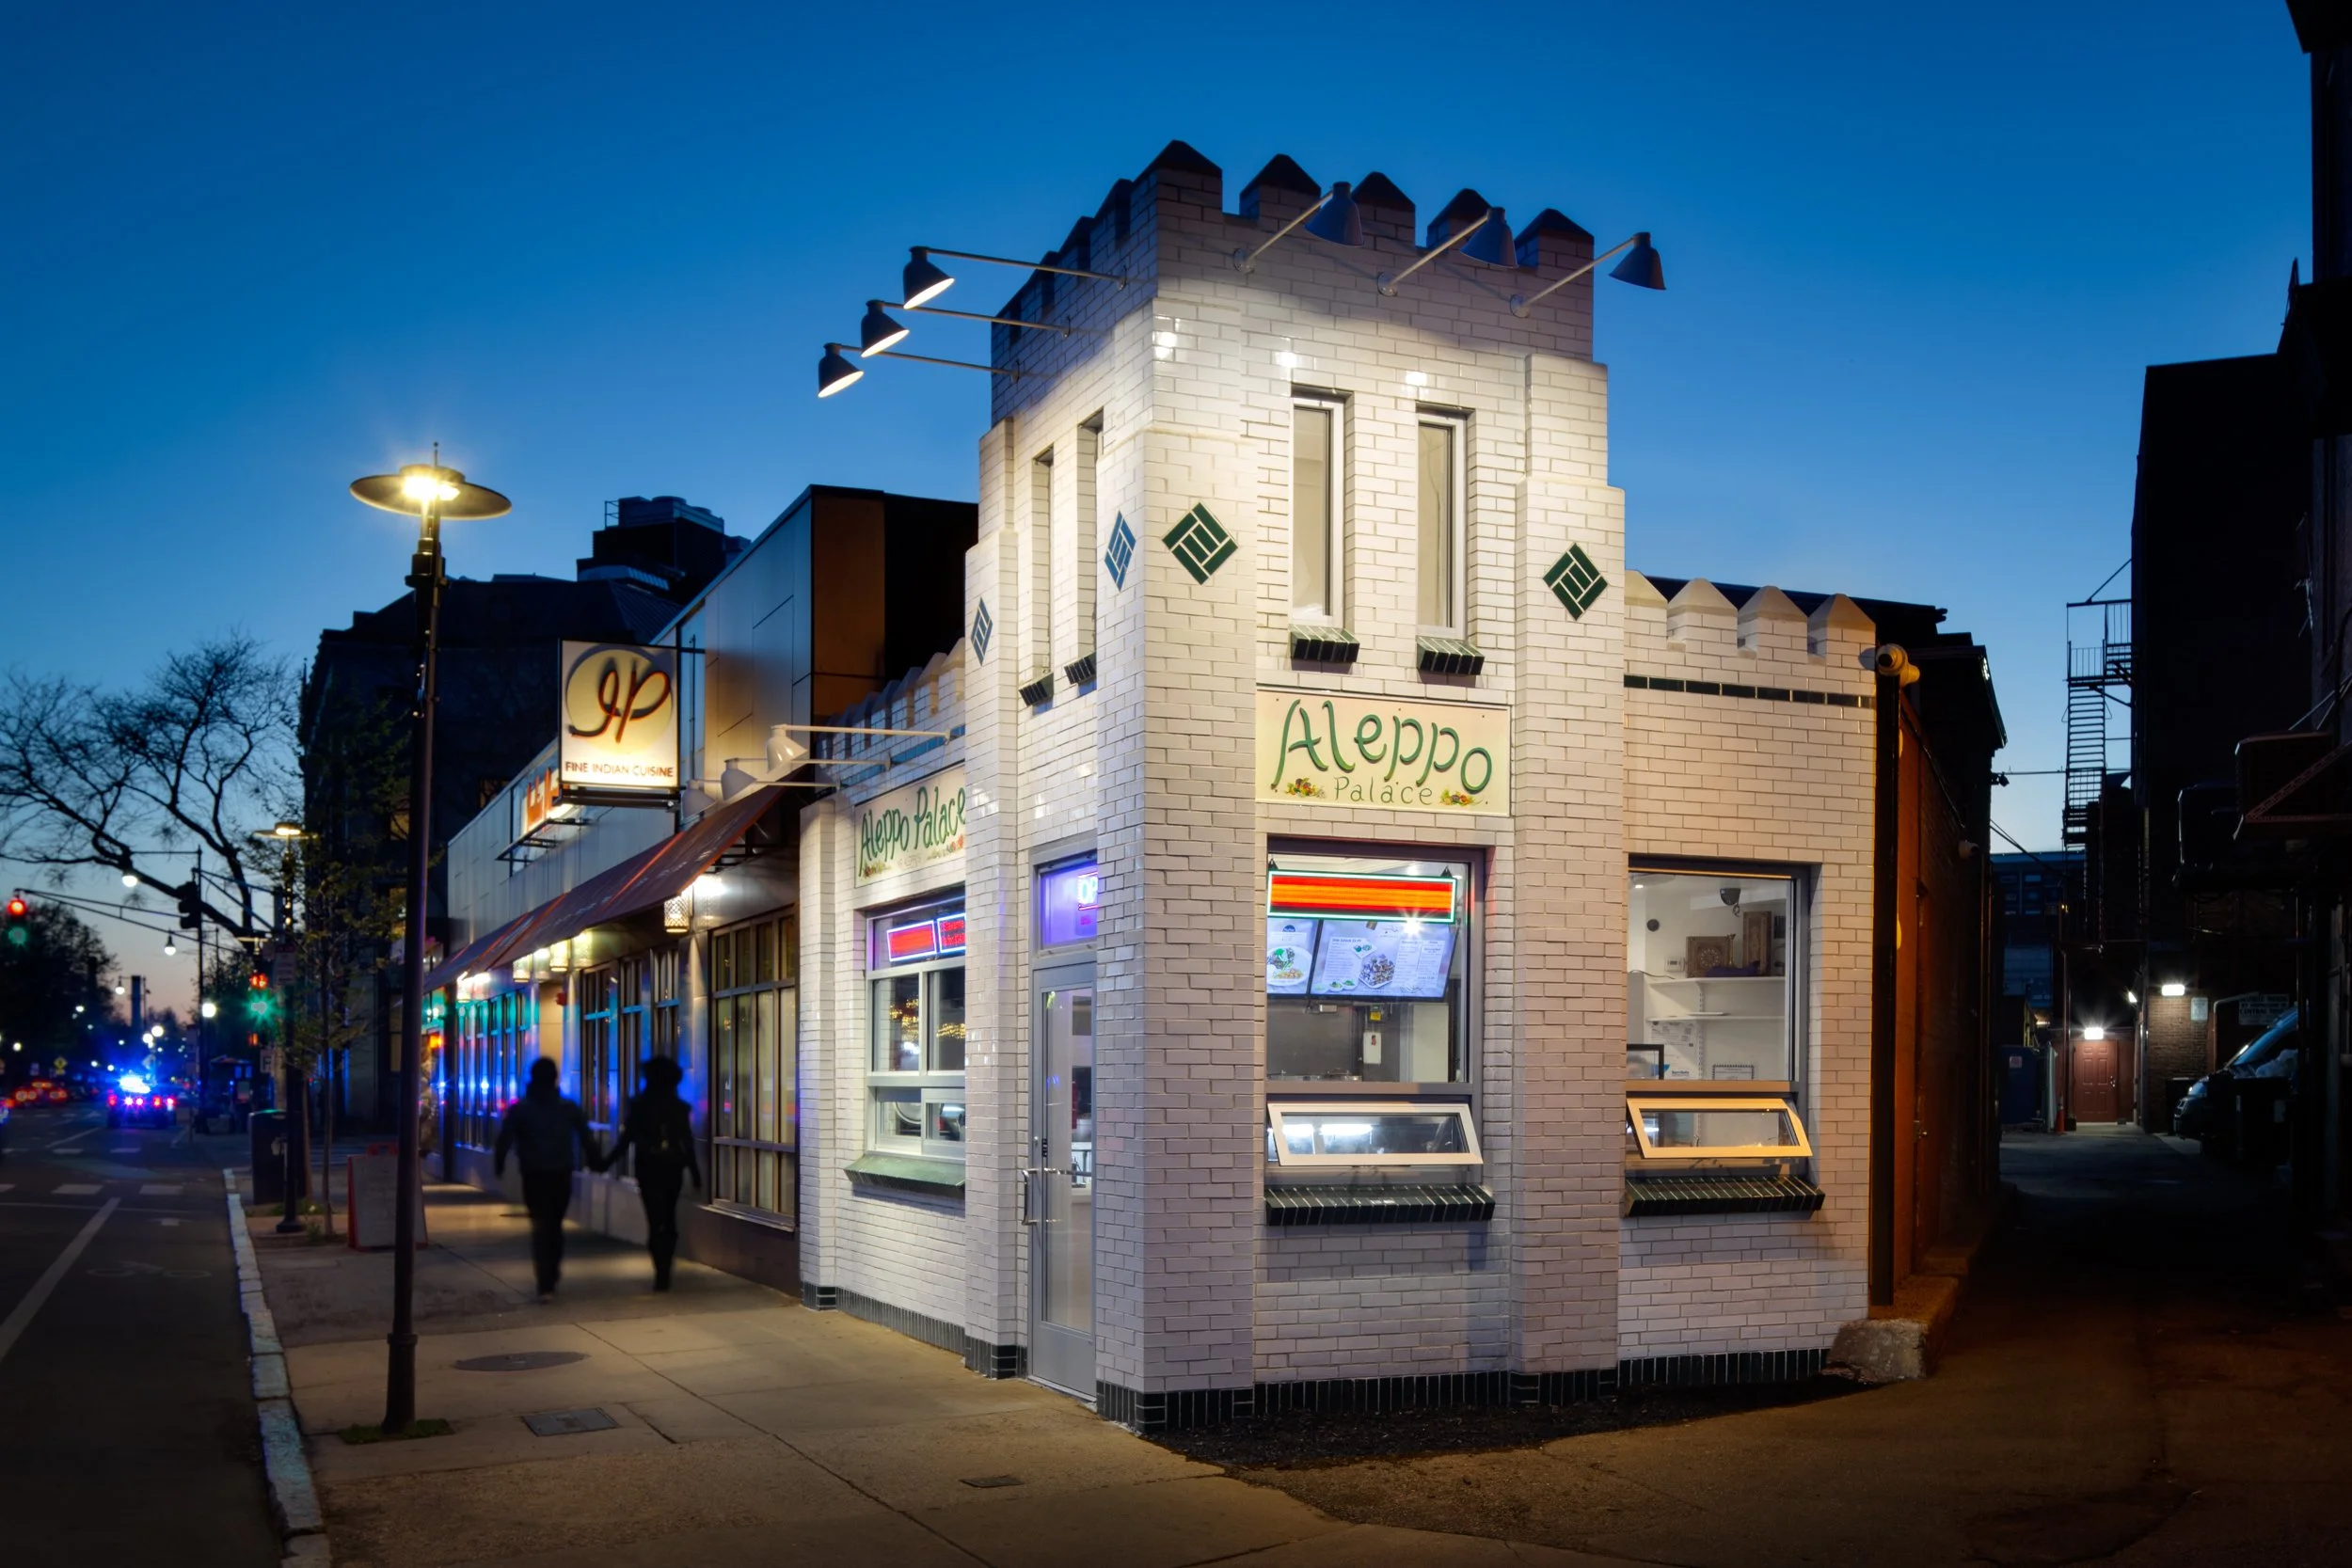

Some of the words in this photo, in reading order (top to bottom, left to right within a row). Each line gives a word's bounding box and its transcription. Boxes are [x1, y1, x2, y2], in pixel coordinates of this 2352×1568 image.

[565, 761, 588, 772] FINE
[593, 763, 629, 774] INDIAN
[633, 766, 674, 777] CUISINE
[1270, 699, 1493, 794] Aleppo
[1333, 776, 1433, 805] Palace
[858, 809, 910, 878] Aleppo
[914, 786, 965, 849] Palace
